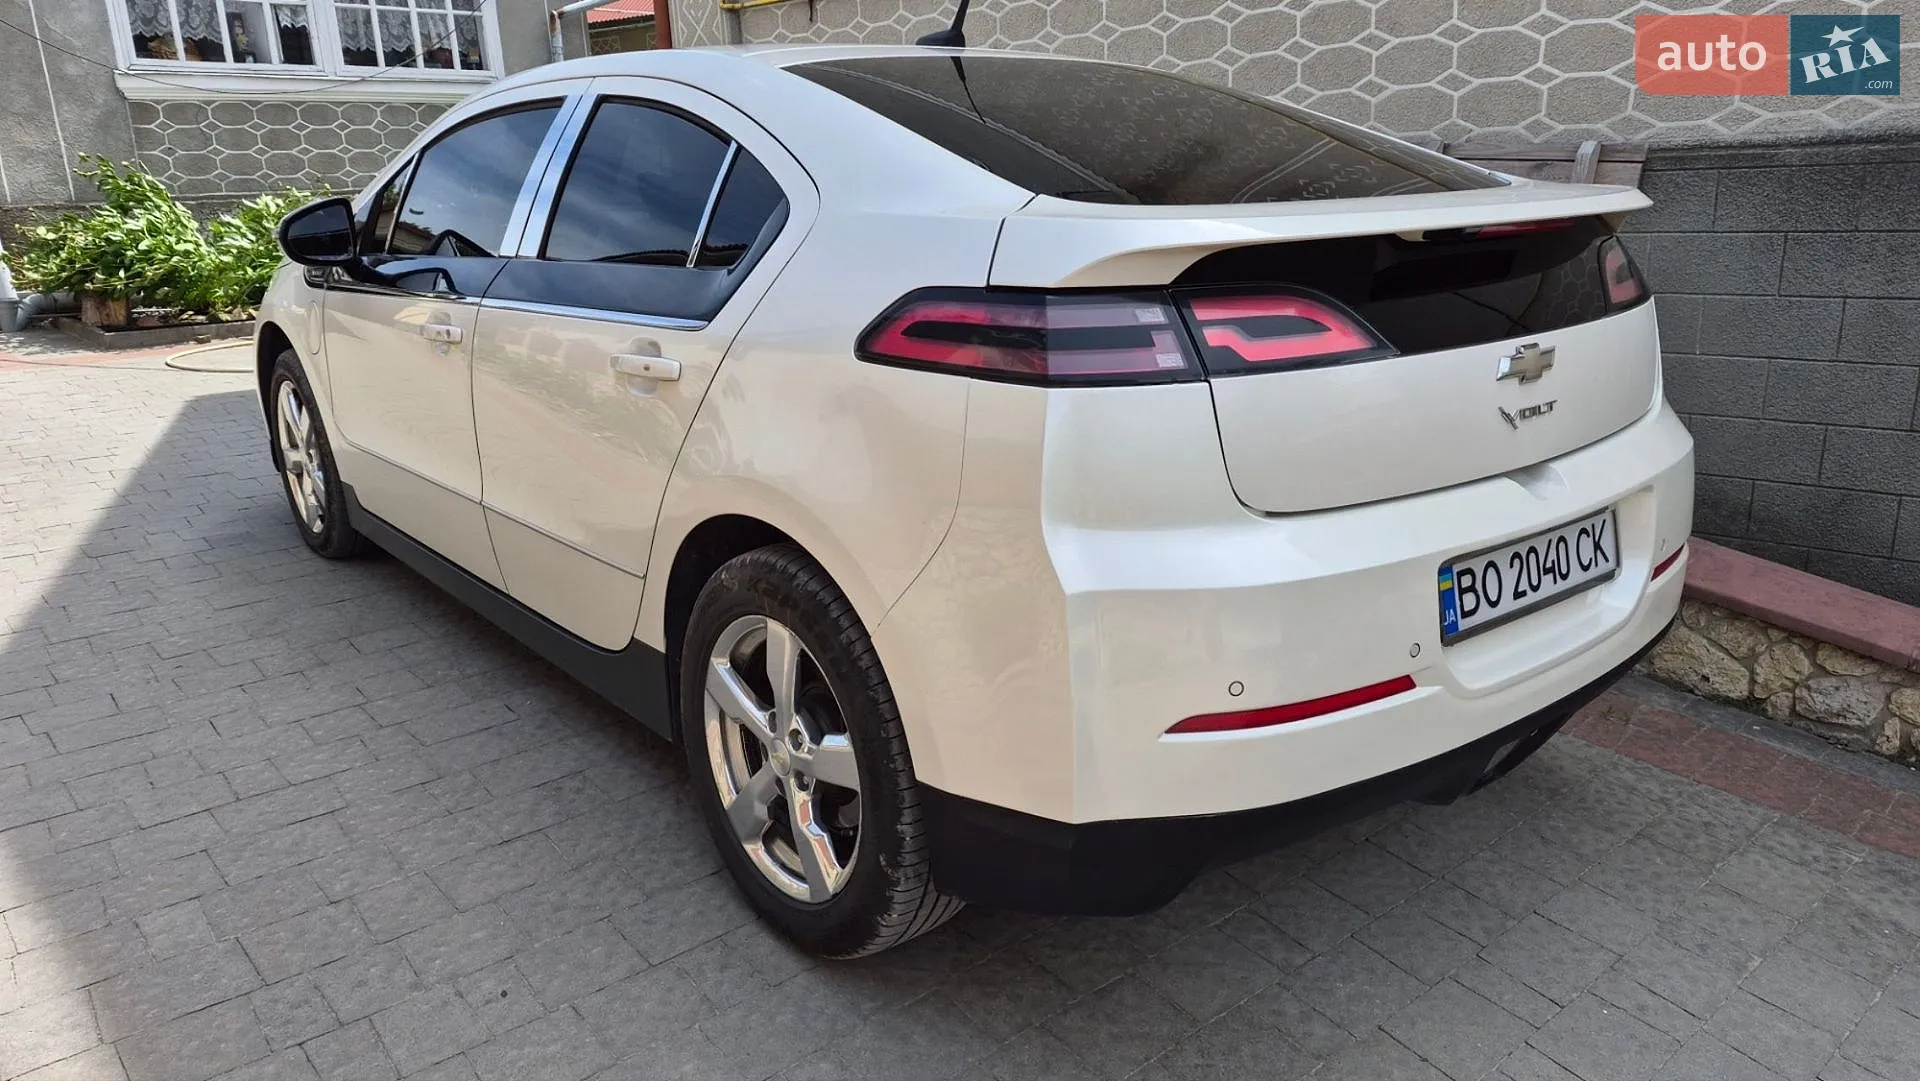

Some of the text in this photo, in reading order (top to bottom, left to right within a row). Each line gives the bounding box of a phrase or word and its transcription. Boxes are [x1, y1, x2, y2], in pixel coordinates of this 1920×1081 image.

[1456, 519, 1610, 619] BO 2040 CK
